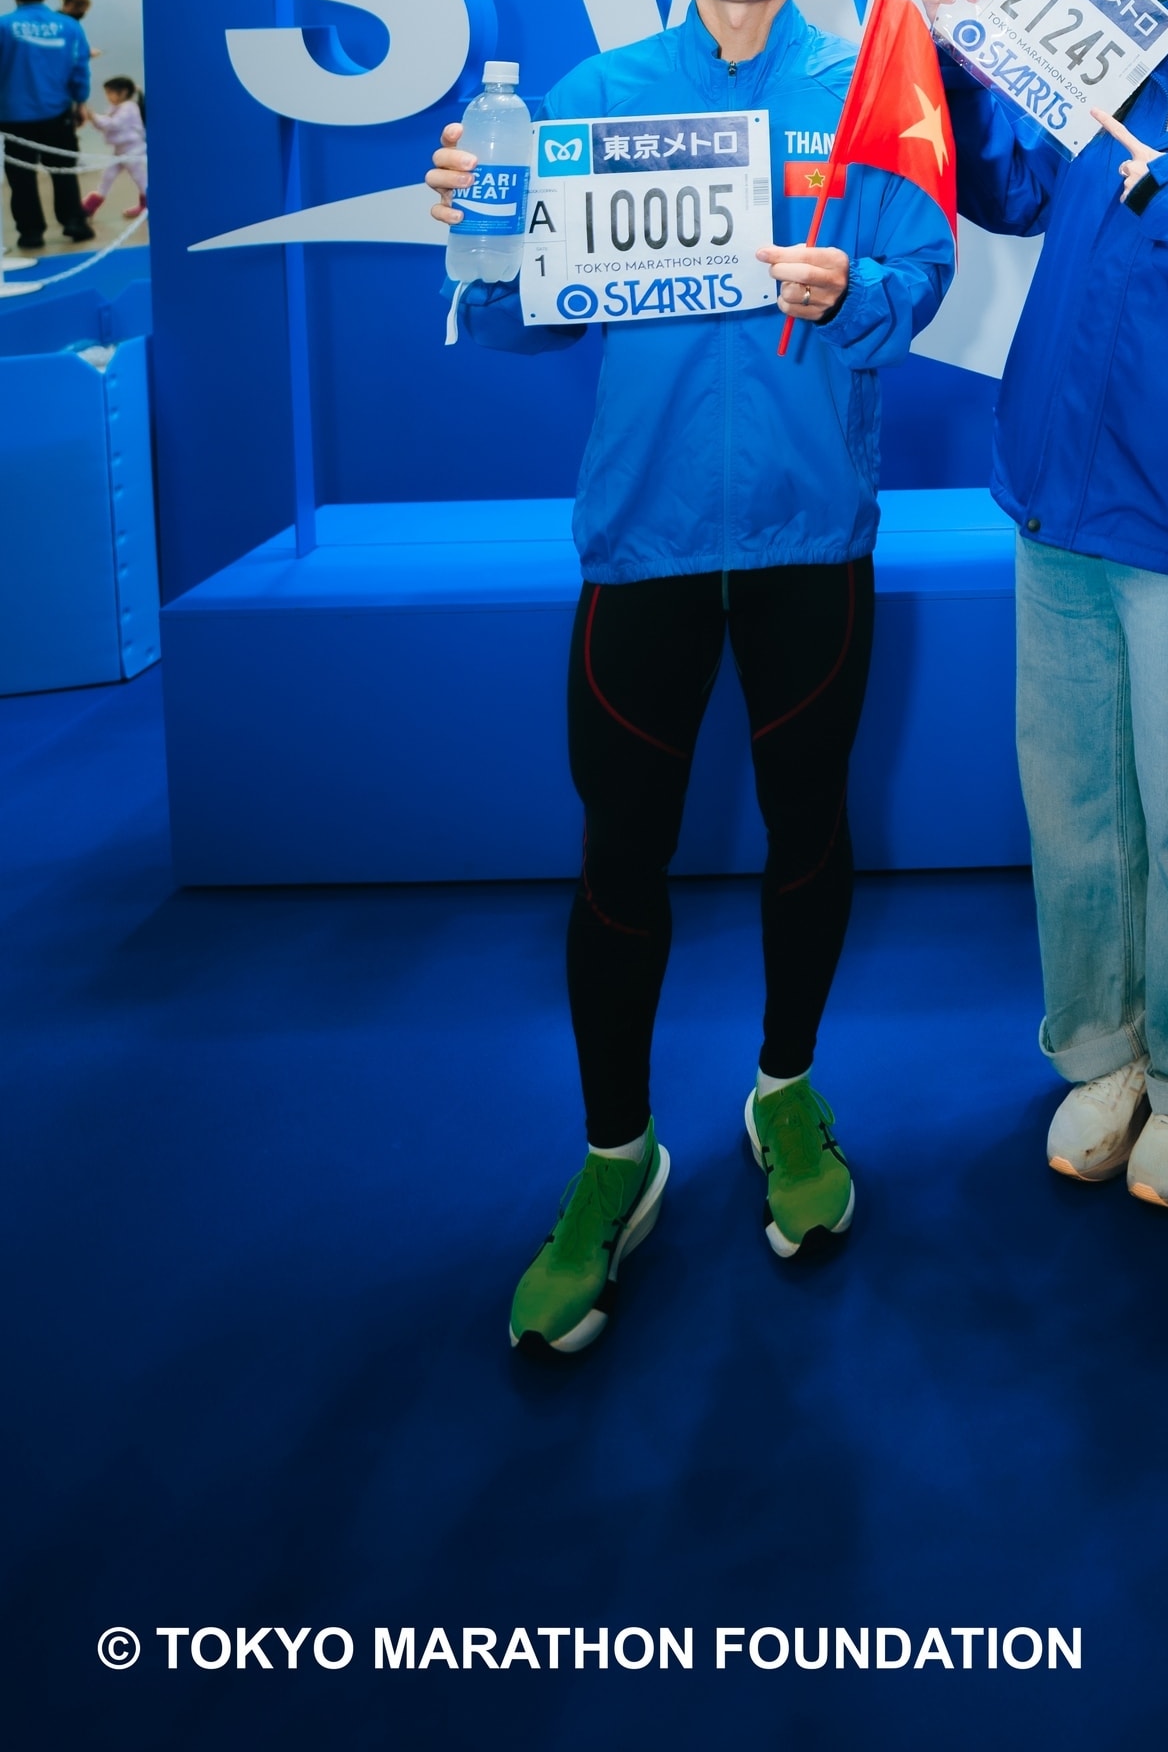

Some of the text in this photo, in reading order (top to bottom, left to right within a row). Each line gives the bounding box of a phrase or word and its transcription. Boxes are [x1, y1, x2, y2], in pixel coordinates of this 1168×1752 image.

[988, 11, 1087, 104] TOKYO MARATHON 2026
[603, 130, 738, 161] 東京メトロ
[528, 200, 557, 234] A
[585, 183, 734, 254] 10005
[535, 254, 546, 277] 1
[574, 254, 739, 275] TOKYO MARATHON 2026
